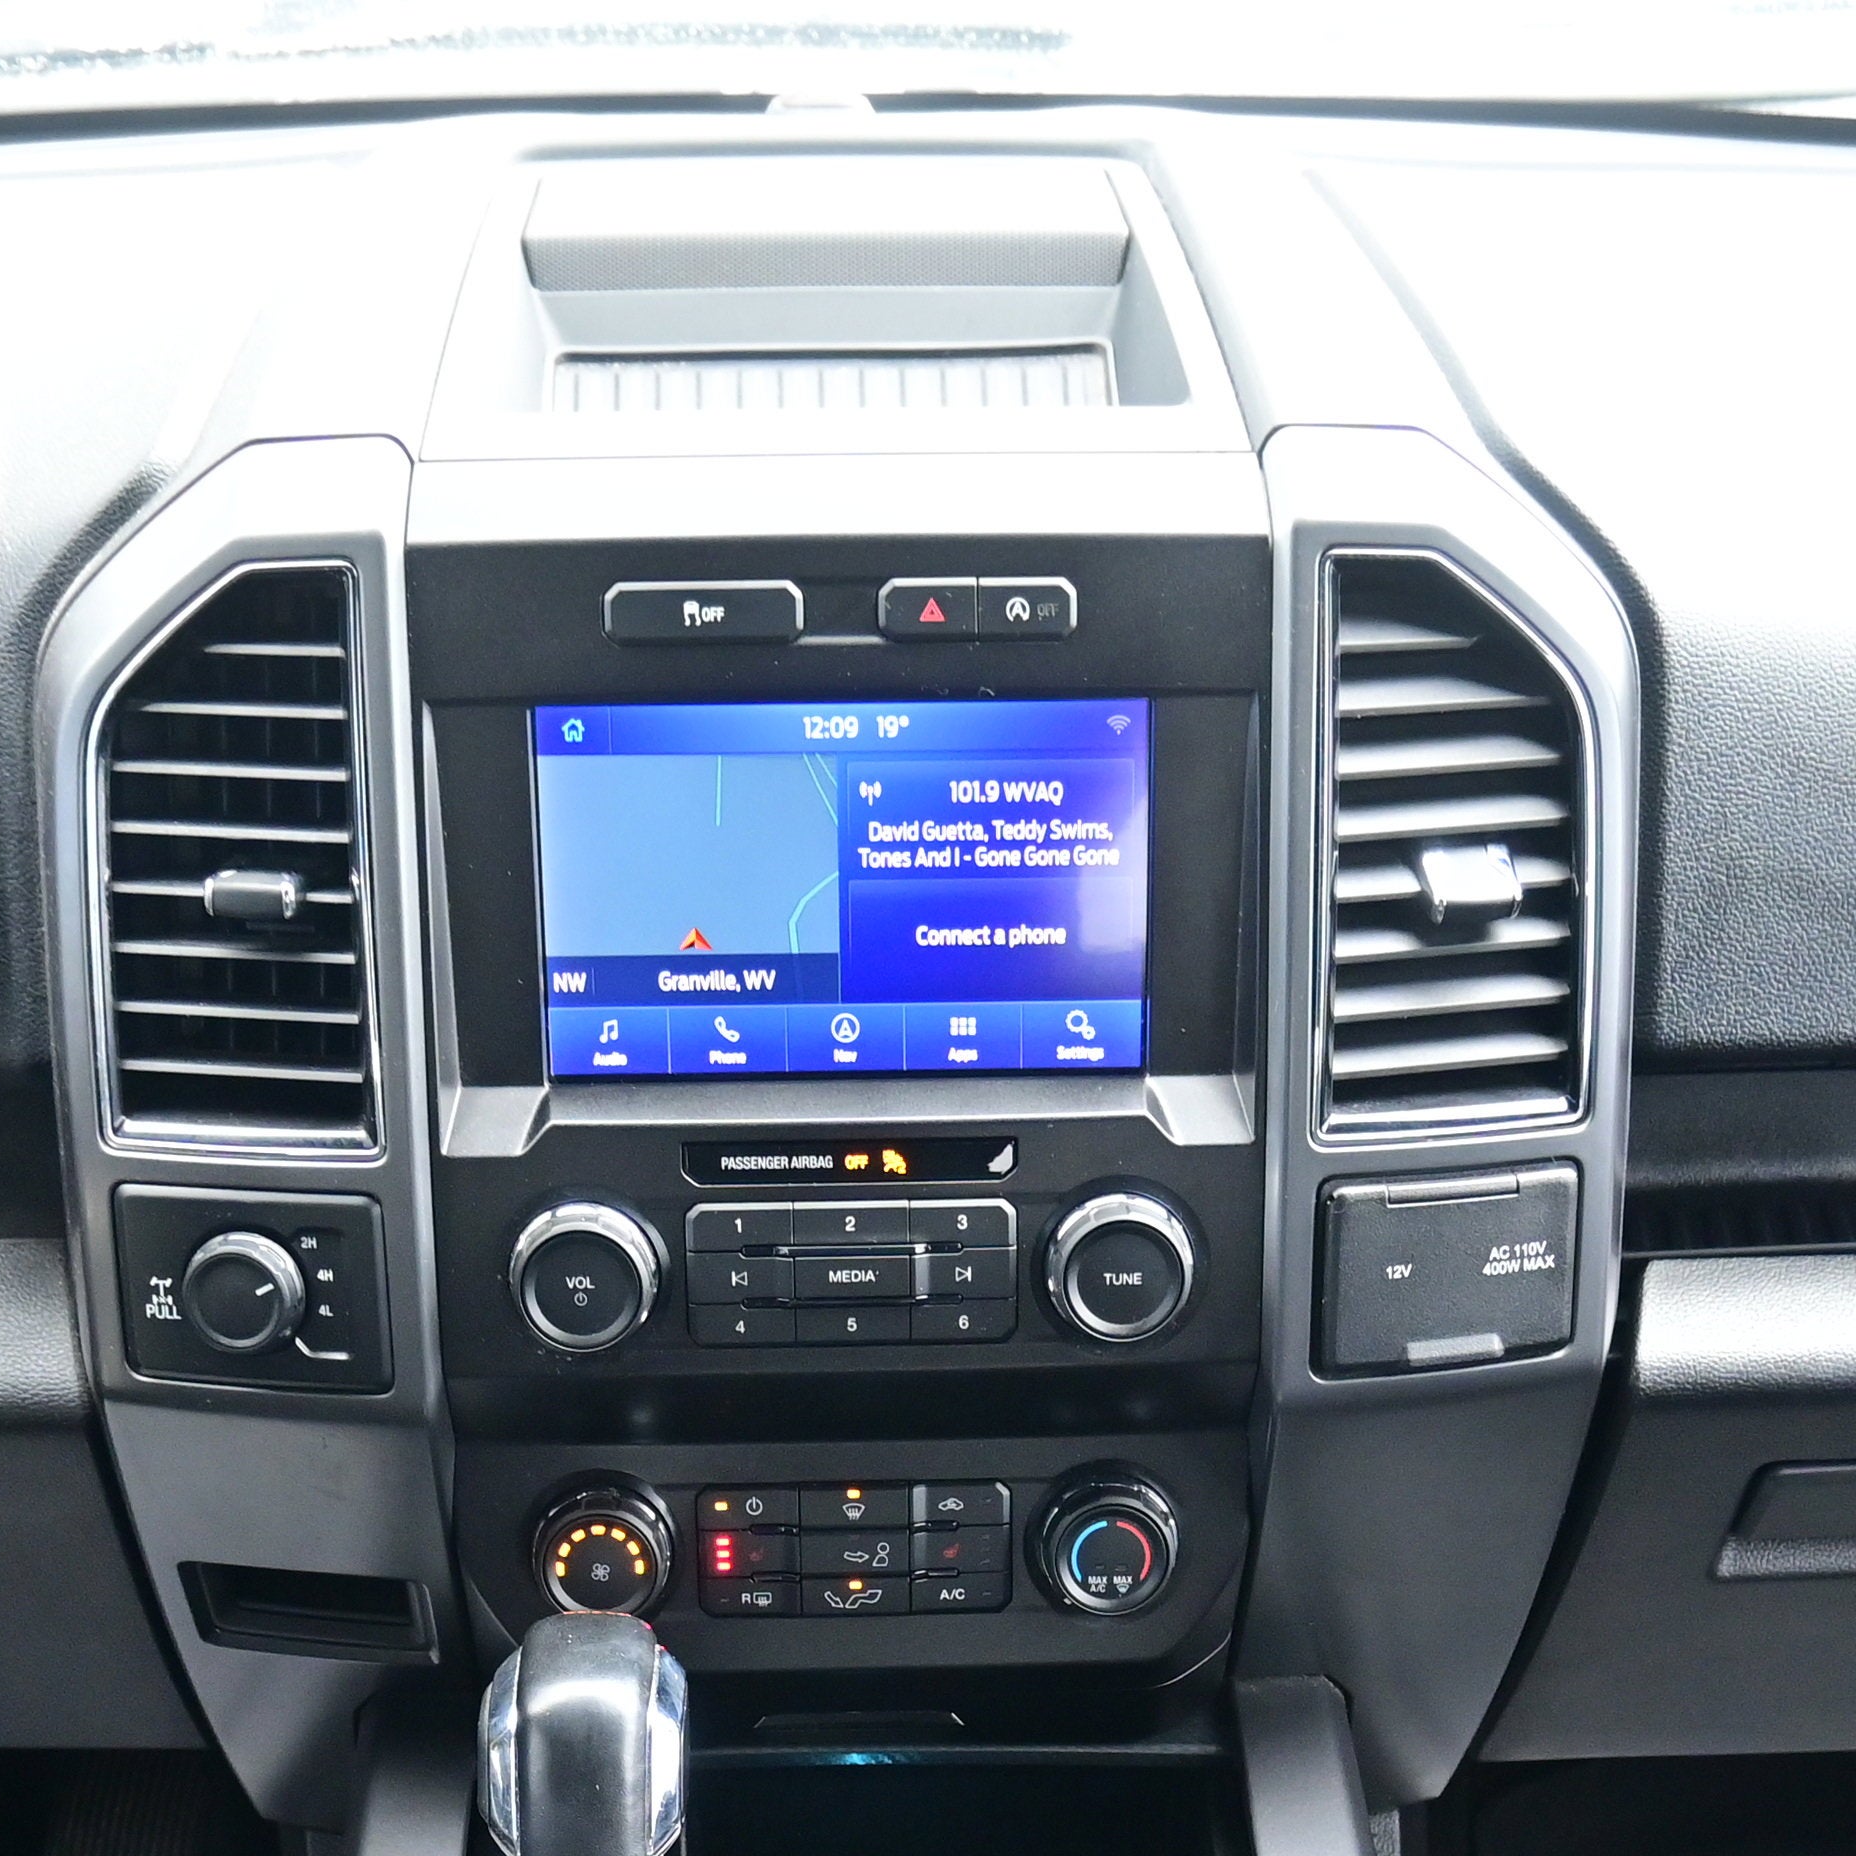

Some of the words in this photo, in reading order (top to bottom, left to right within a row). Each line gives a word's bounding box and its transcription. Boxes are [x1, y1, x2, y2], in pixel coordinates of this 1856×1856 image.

[701, 606, 725, 623] OFF
[802, 715, 859, 740] 12:09
[875, 715, 910, 739] 19°
[949, 781, 999, 804] 101.9
[1003, 780, 1064, 805] WVAQ
[868, 820, 919, 843] David
[922, 820, 989, 845] Guetta,
[992, 820, 1048, 848] Teddy
[1050, 820, 1114, 844] Swims,
[858, 846, 912, 868] Tones
[915, 846, 952, 868] And
[975, 846, 1021, 867] Gone
[1024, 846, 1070, 867] Gone
[1073, 845, 1120, 867] Gone
[915, 925, 989, 948] Connect
[993, 930, 1006, 946] a
[1009, 925, 1066, 949] phone
[552, 973, 587, 994] NW
[658, 969, 741, 994] Granville,
[743, 969, 777, 992] WV
[592, 1050, 628, 1068] Audio
[708, 1048, 748, 1065] Phone
[833, 1047, 858, 1063] Nav
[948, 1047, 978, 1065] Apps
[1056, 1044, 1105, 1063] Settings
[720, 1156, 789, 1171] PASSENGER
[791, 1154, 834, 1169] AIRBAG
[844, 1154, 869, 1170] OFF
[733, 1218, 743, 1234] 1
[845, 1216, 856, 1232] 2
[956, 1214, 968, 1230] 3
[300, 1235, 317, 1249] 2H
[1489, 1246, 1510, 1261] AC
[1513, 1240, 1547, 1258] 110V
[1385, 1263, 1413, 1280] 12V
[1482, 1258, 1521, 1276] 400W
[1523, 1254, 1555, 1272] MAX
[316, 1269, 334, 1282] 4H
[565, 1275, 596, 1290] VOL
[829, 1269, 876, 1284] MEDIA
[1103, 1272, 1144, 1286] TUNE
[146, 1304, 182, 1320] PULL
[318, 1304, 334, 1318] 4L
[735, 1320, 746, 1334] 4
[846, 1318, 857, 1332] 5
[958, 1315, 969, 1330] 6
[1088, 1576, 1107, 1584] MAX
[1113, 1575, 1133, 1584] MAX
[939, 1589, 966, 1601] A/C
[1090, 1584, 1106, 1593] A/C
[741, 1593, 751, 1604] R
